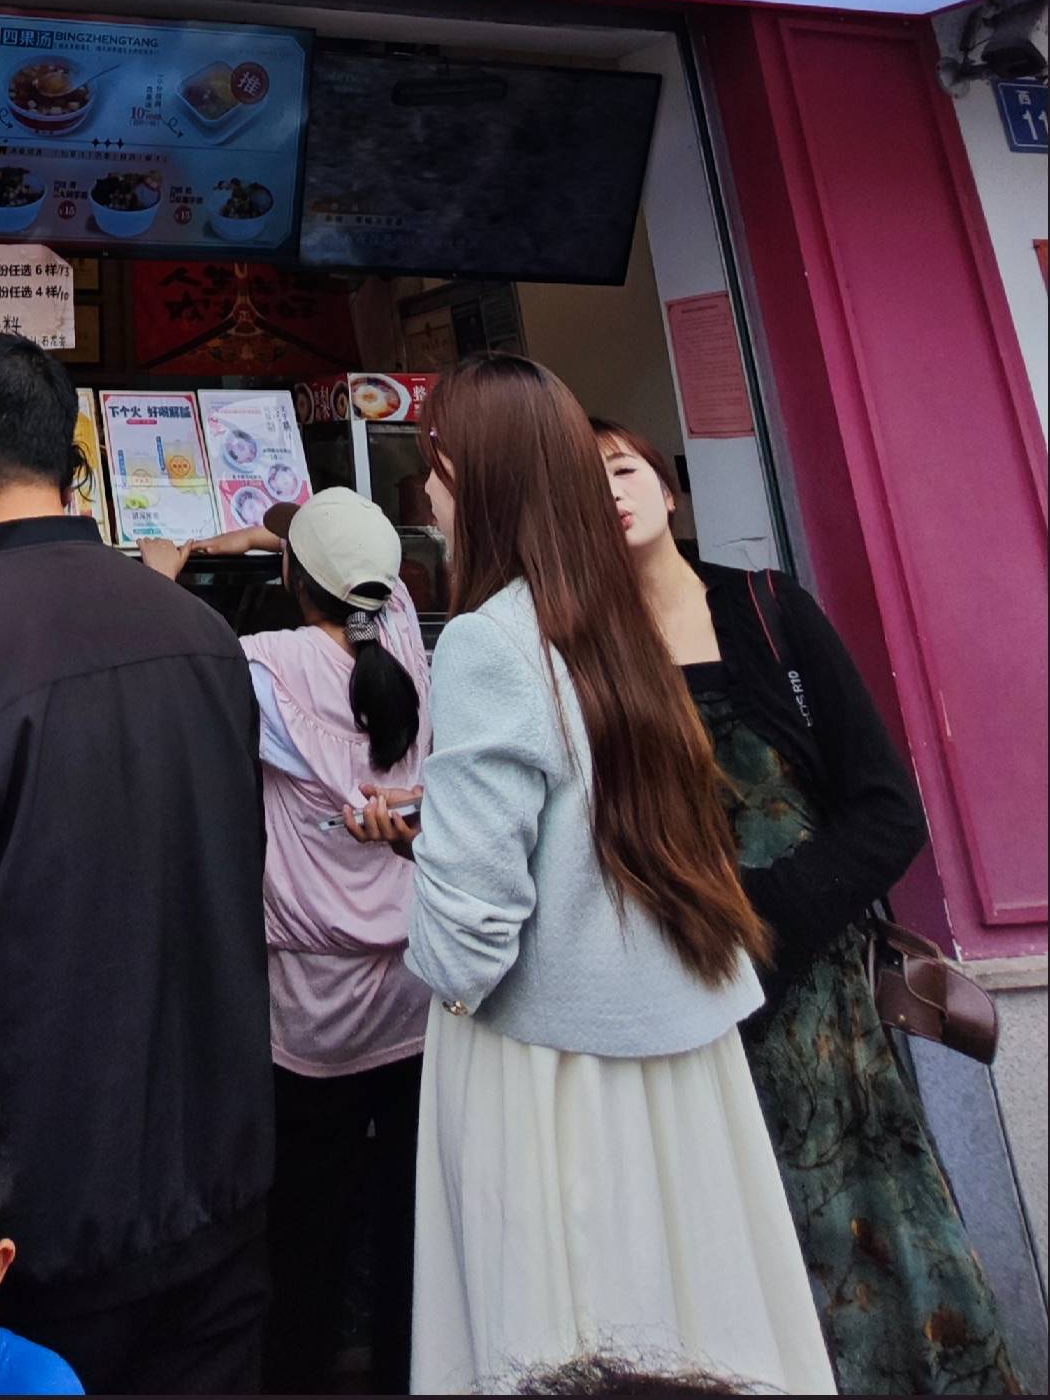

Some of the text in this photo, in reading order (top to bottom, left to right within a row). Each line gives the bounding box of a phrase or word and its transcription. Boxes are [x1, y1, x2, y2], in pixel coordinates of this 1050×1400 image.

[56, 31, 159, 49] BINGZHENGTANG
[238, 70, 261, 96] 推
[35, 264, 42, 276] 6
[36, 285, 43, 297] 4
